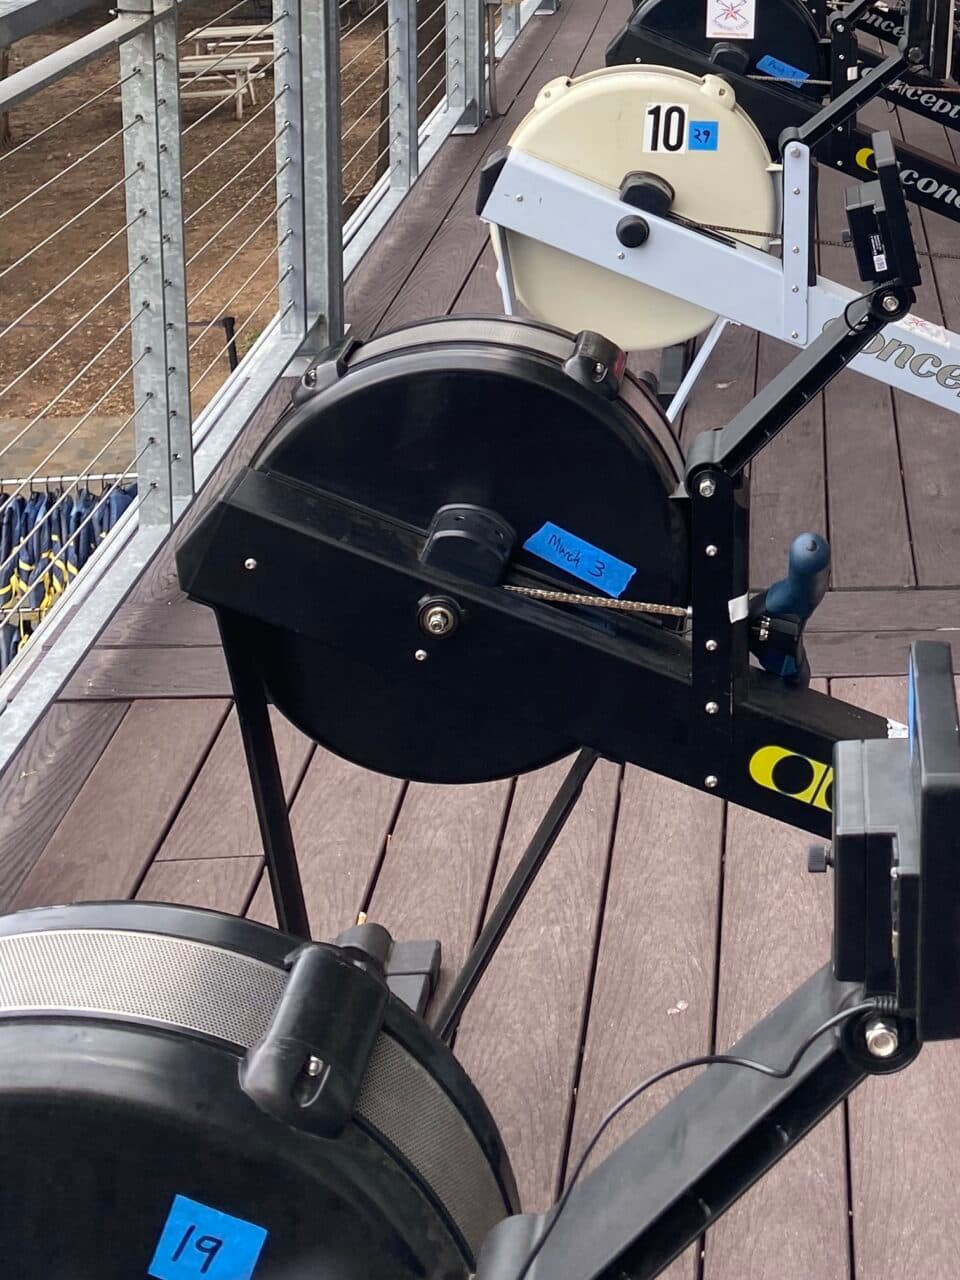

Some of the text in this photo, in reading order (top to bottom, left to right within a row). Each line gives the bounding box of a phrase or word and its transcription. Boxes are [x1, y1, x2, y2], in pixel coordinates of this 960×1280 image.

[648, 105, 685, 151] 10
[589, 559, 606, 578] 3
[171, 1224, 223, 1274] 19
